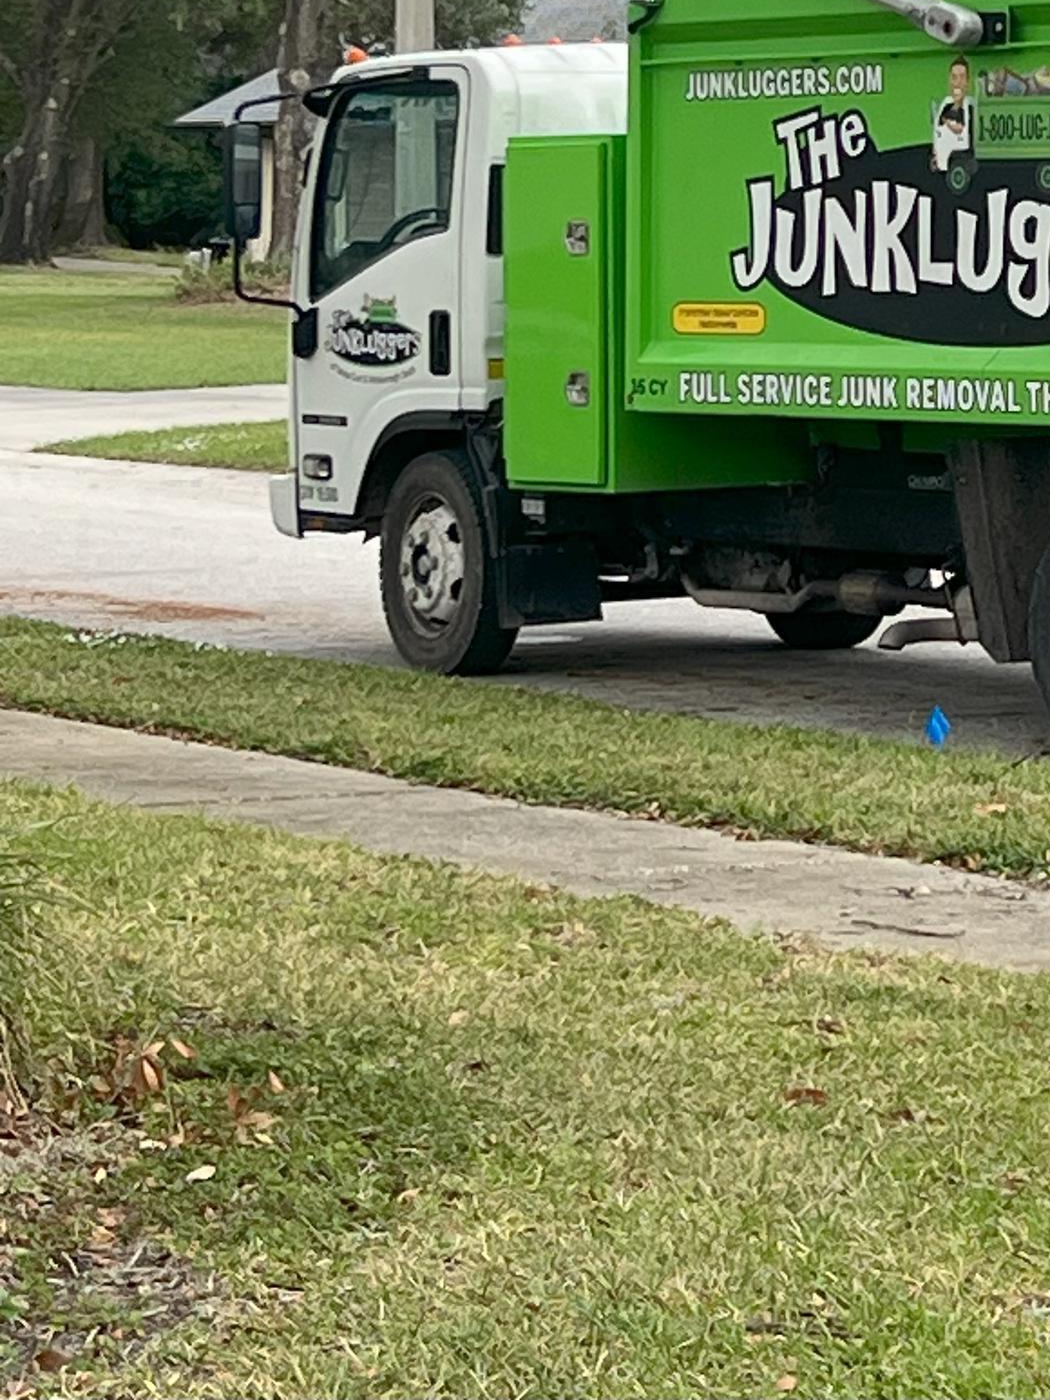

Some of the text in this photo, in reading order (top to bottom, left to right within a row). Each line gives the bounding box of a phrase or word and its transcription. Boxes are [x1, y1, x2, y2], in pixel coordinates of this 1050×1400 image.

[686, 65, 883, 100] JUNKLUGGERS.COM
[650, 379, 668, 395] CY
[679, 372, 732, 403] FULL
[737, 374, 832, 406] SERVICE
[838, 376, 898, 408] JUNK
[905, 378, 1021, 412] REMOVAL
